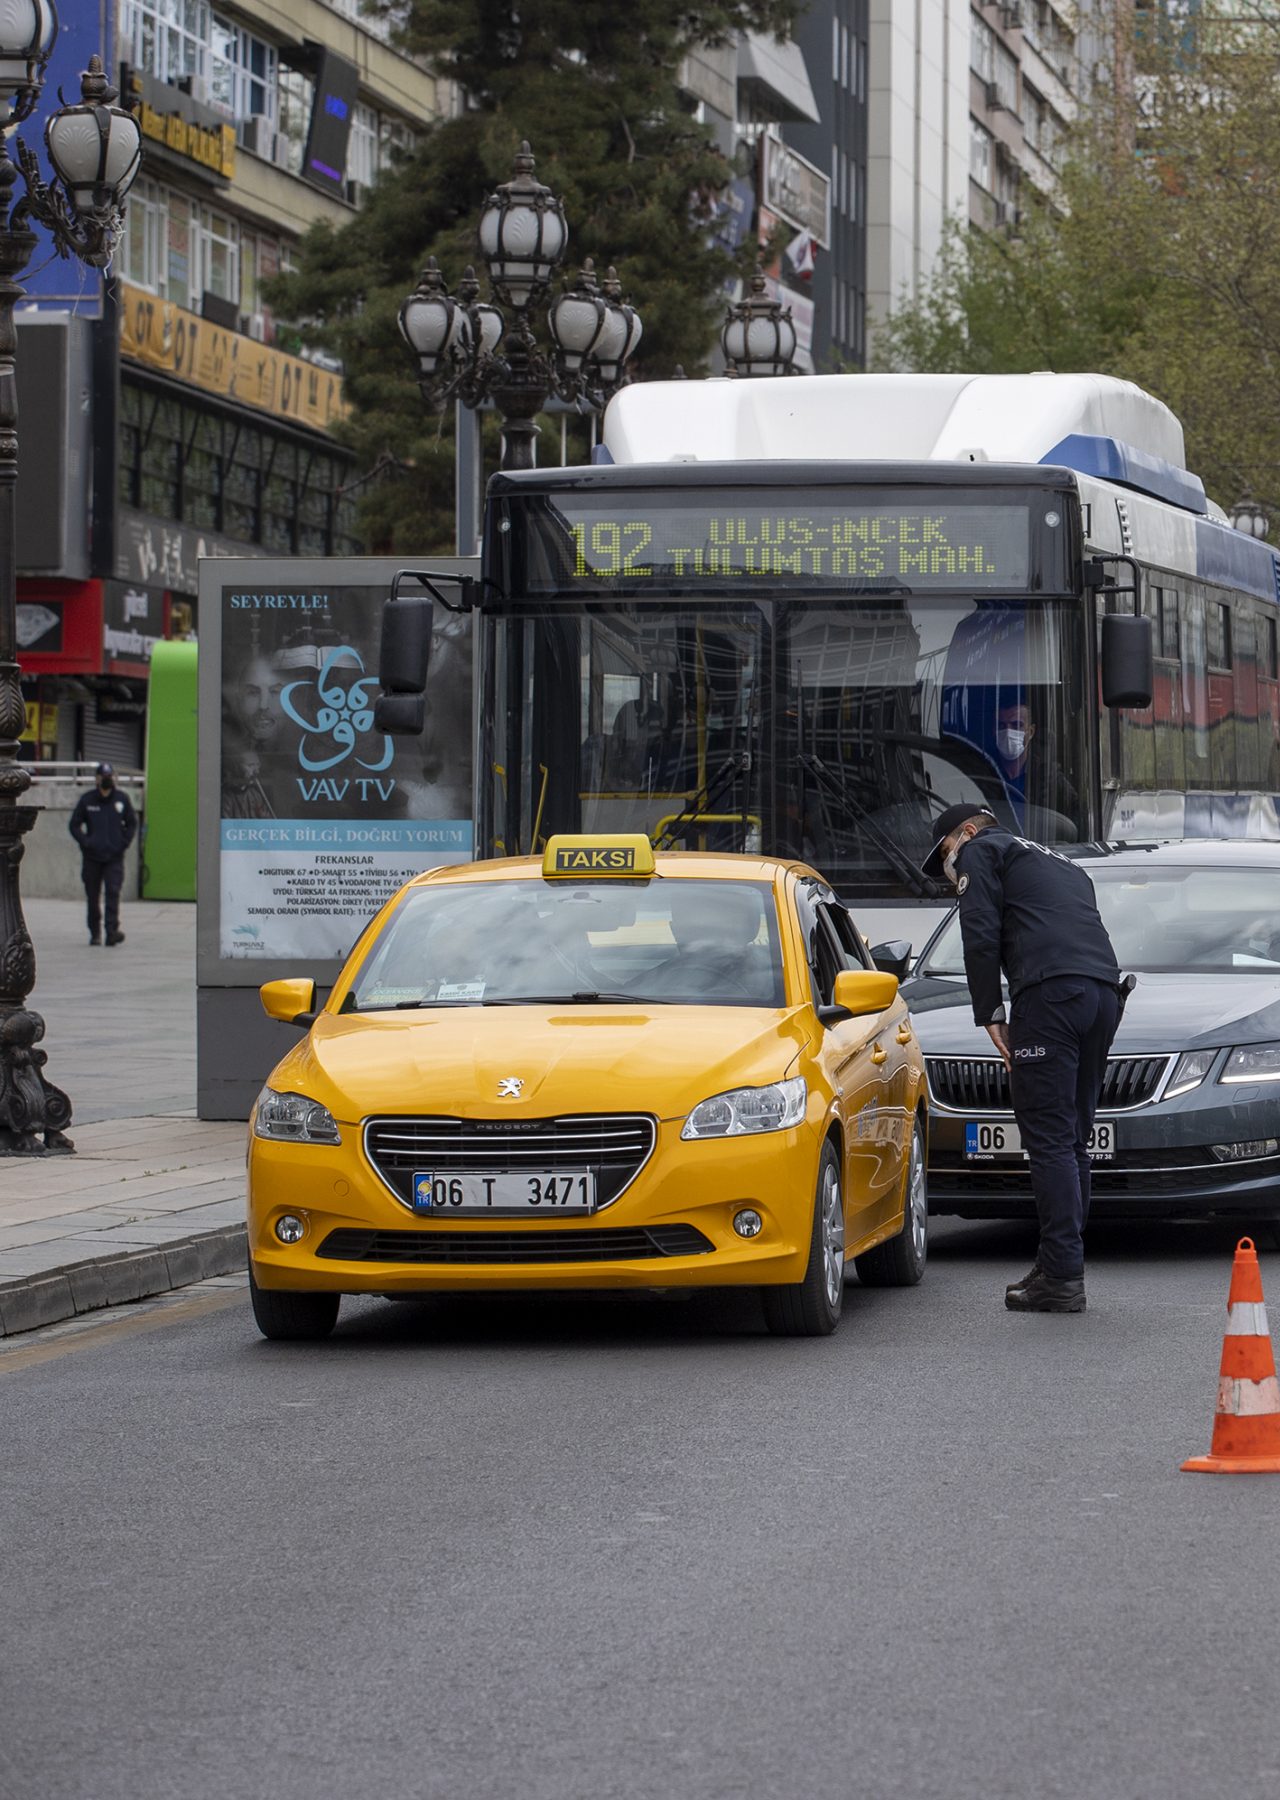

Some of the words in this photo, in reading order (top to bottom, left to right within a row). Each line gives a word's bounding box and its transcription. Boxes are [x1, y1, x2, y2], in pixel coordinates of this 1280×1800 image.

[569, 522, 652, 577] 192
[899, 545, 996, 574] MAH.
[230, 594, 329, 609] SEYREYLE!
[296, 778, 350, 801] VAV
[355, 778, 396, 801] TV
[225, 829, 291, 844] GERÇEK
[295, 826, 343, 843] BİLGİ,
[346, 827, 401, 843] DOĞRU
[404, 829, 464, 843] YORUM
[315, 855, 374, 865] FREKANSLAR
[292, 879, 316, 887] KABLO
[317, 879, 326, 887] TV
[328, 879, 337, 887] 45
[344, 879, 382, 888] VODAFONE
[383, 879, 392, 888] TV
[296, 886, 326, 896] TÜRKSAT
[328, 888, 338, 896] 4A
[339, 888, 372, 897] FREKANS:
[247, 907, 275, 915] SEMBOL
[300, 907, 332, 916] (SYMBOL
[333, 908, 355, 917] RATE):
[476, 1123, 541, 1131] PEUGEOT
[967, 1140, 978, 1148] TR
[979, 1125, 1006, 1150] 06
[432, 1177, 463, 1207] 06
[482, 1178, 496, 1206] T
[527, 1176, 588, 1206] 3471
